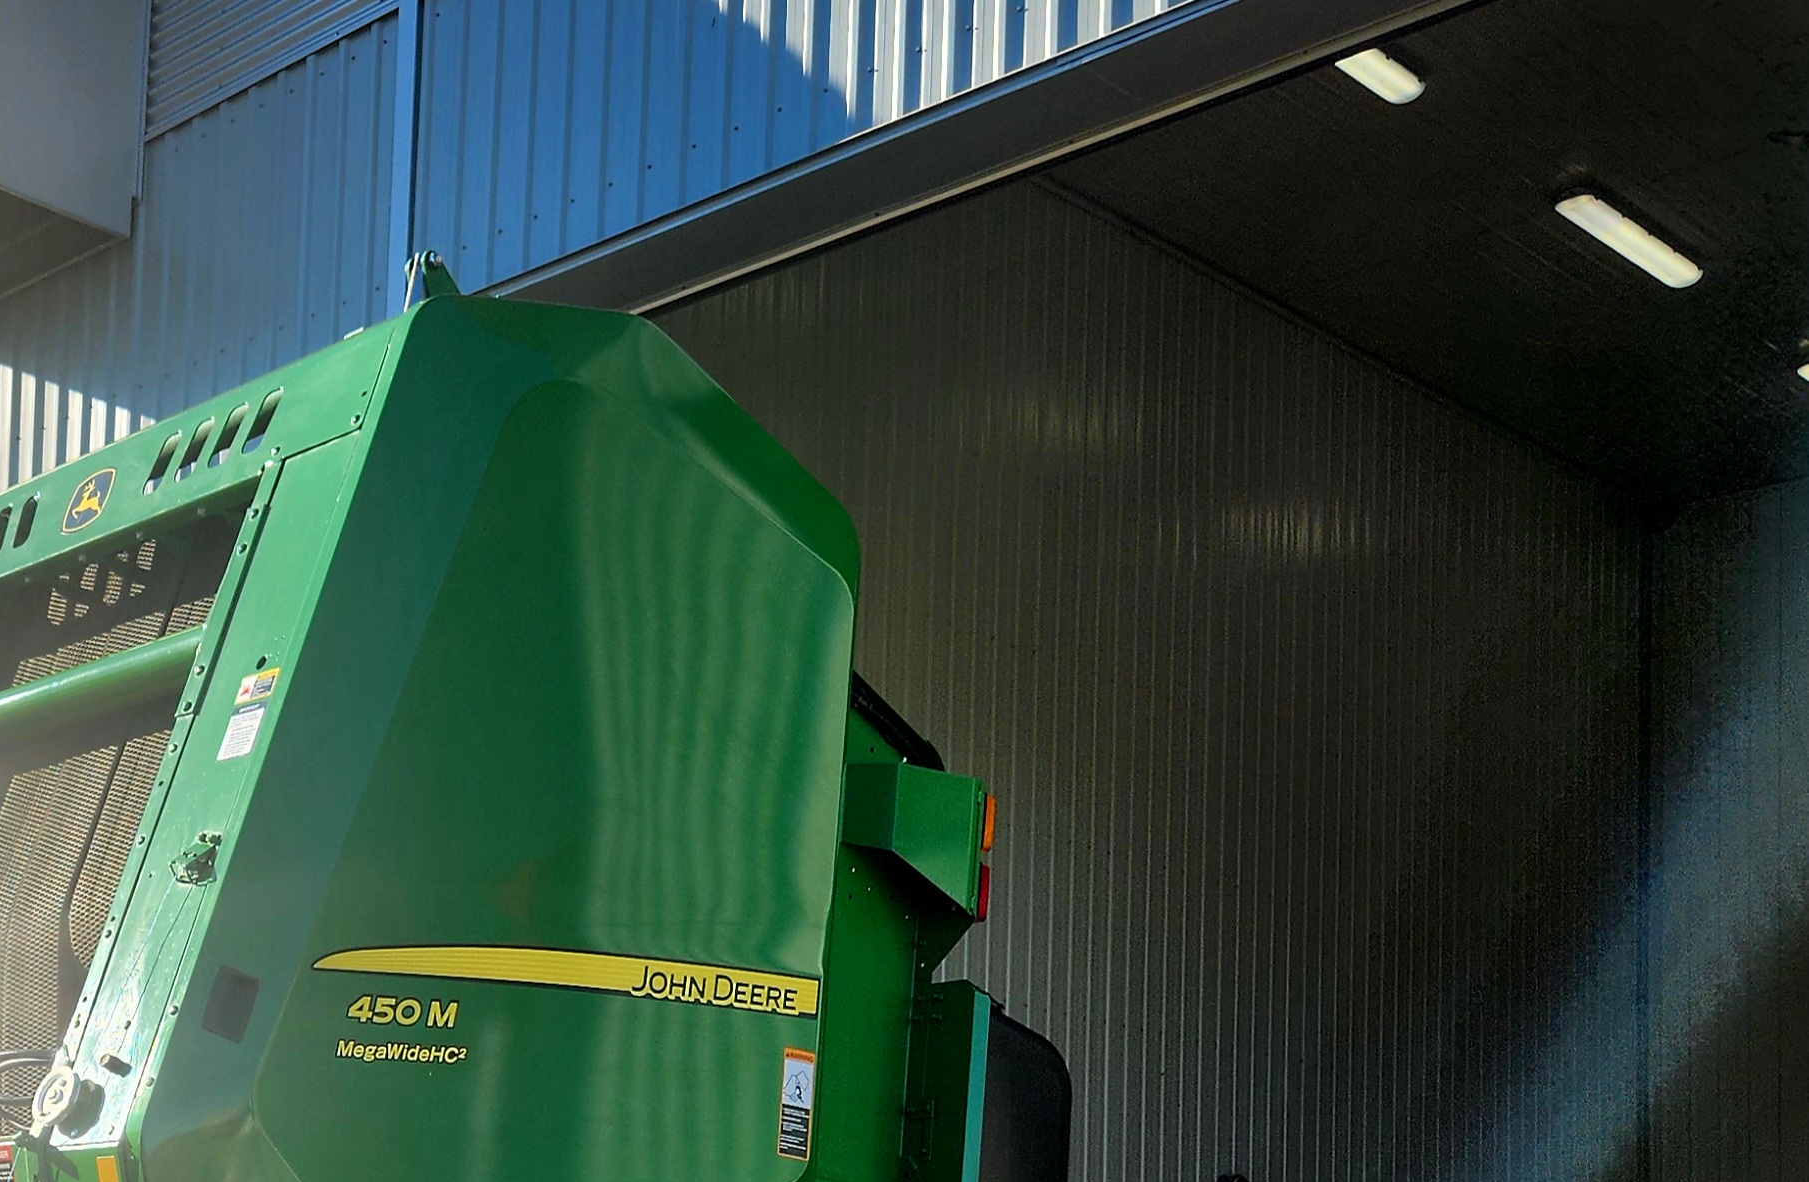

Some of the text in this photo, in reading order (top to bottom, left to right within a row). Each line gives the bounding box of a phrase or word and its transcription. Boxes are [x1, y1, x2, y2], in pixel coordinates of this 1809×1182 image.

[631, 965, 799, 1012] JOHN DEERE
[346, 995, 459, 1028] 450 M
